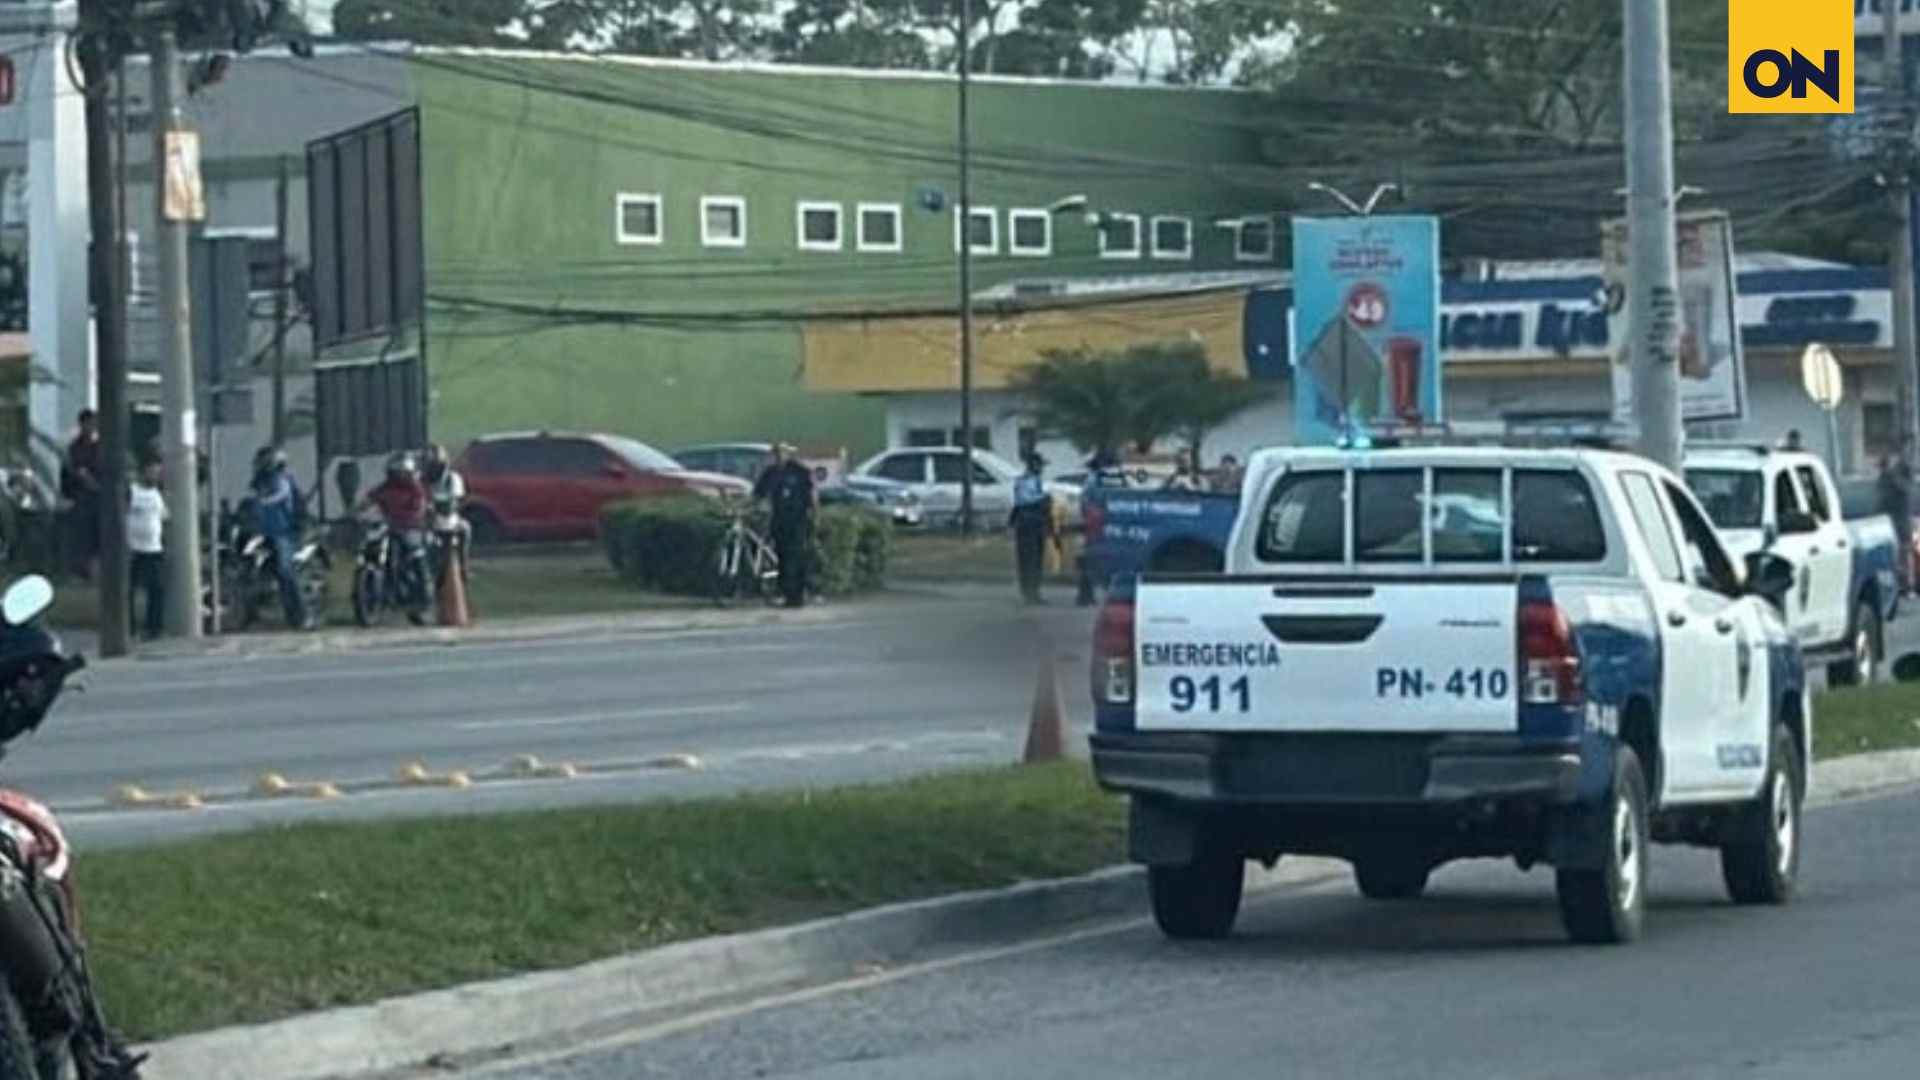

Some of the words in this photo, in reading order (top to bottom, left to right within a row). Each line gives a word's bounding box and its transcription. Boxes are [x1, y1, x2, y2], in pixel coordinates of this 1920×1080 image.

[1141, 642, 1281, 666] EMERGENCIA
[1169, 674, 1250, 713] 911
[1445, 667, 1508, 699] 410
